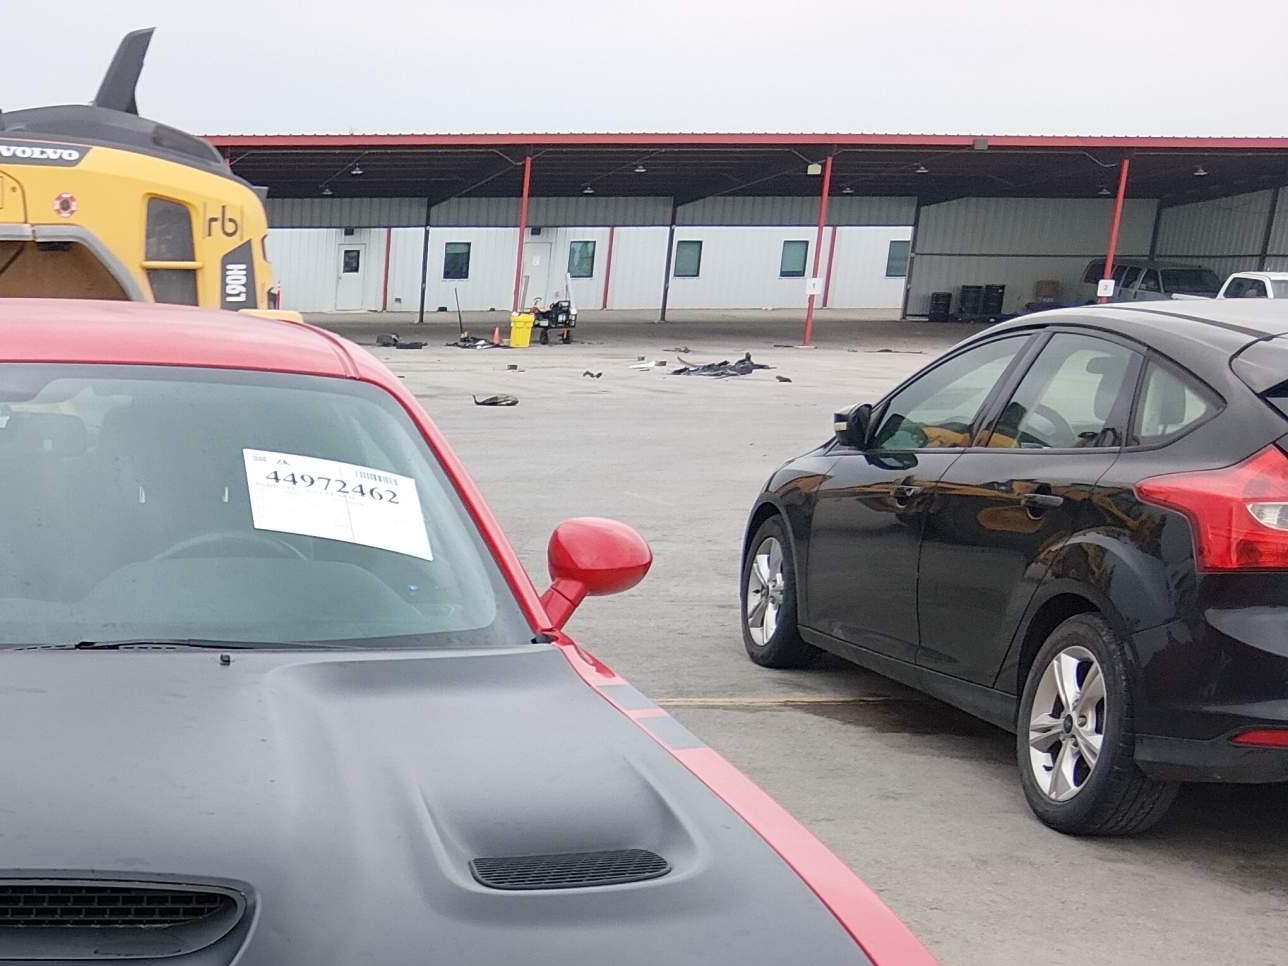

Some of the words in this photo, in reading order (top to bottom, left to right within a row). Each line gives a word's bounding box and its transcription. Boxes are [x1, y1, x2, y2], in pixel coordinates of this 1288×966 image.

[207, 205, 238, 237] rb
[225, 264, 247, 302] L90H
[265, 470, 400, 504] 44972462
